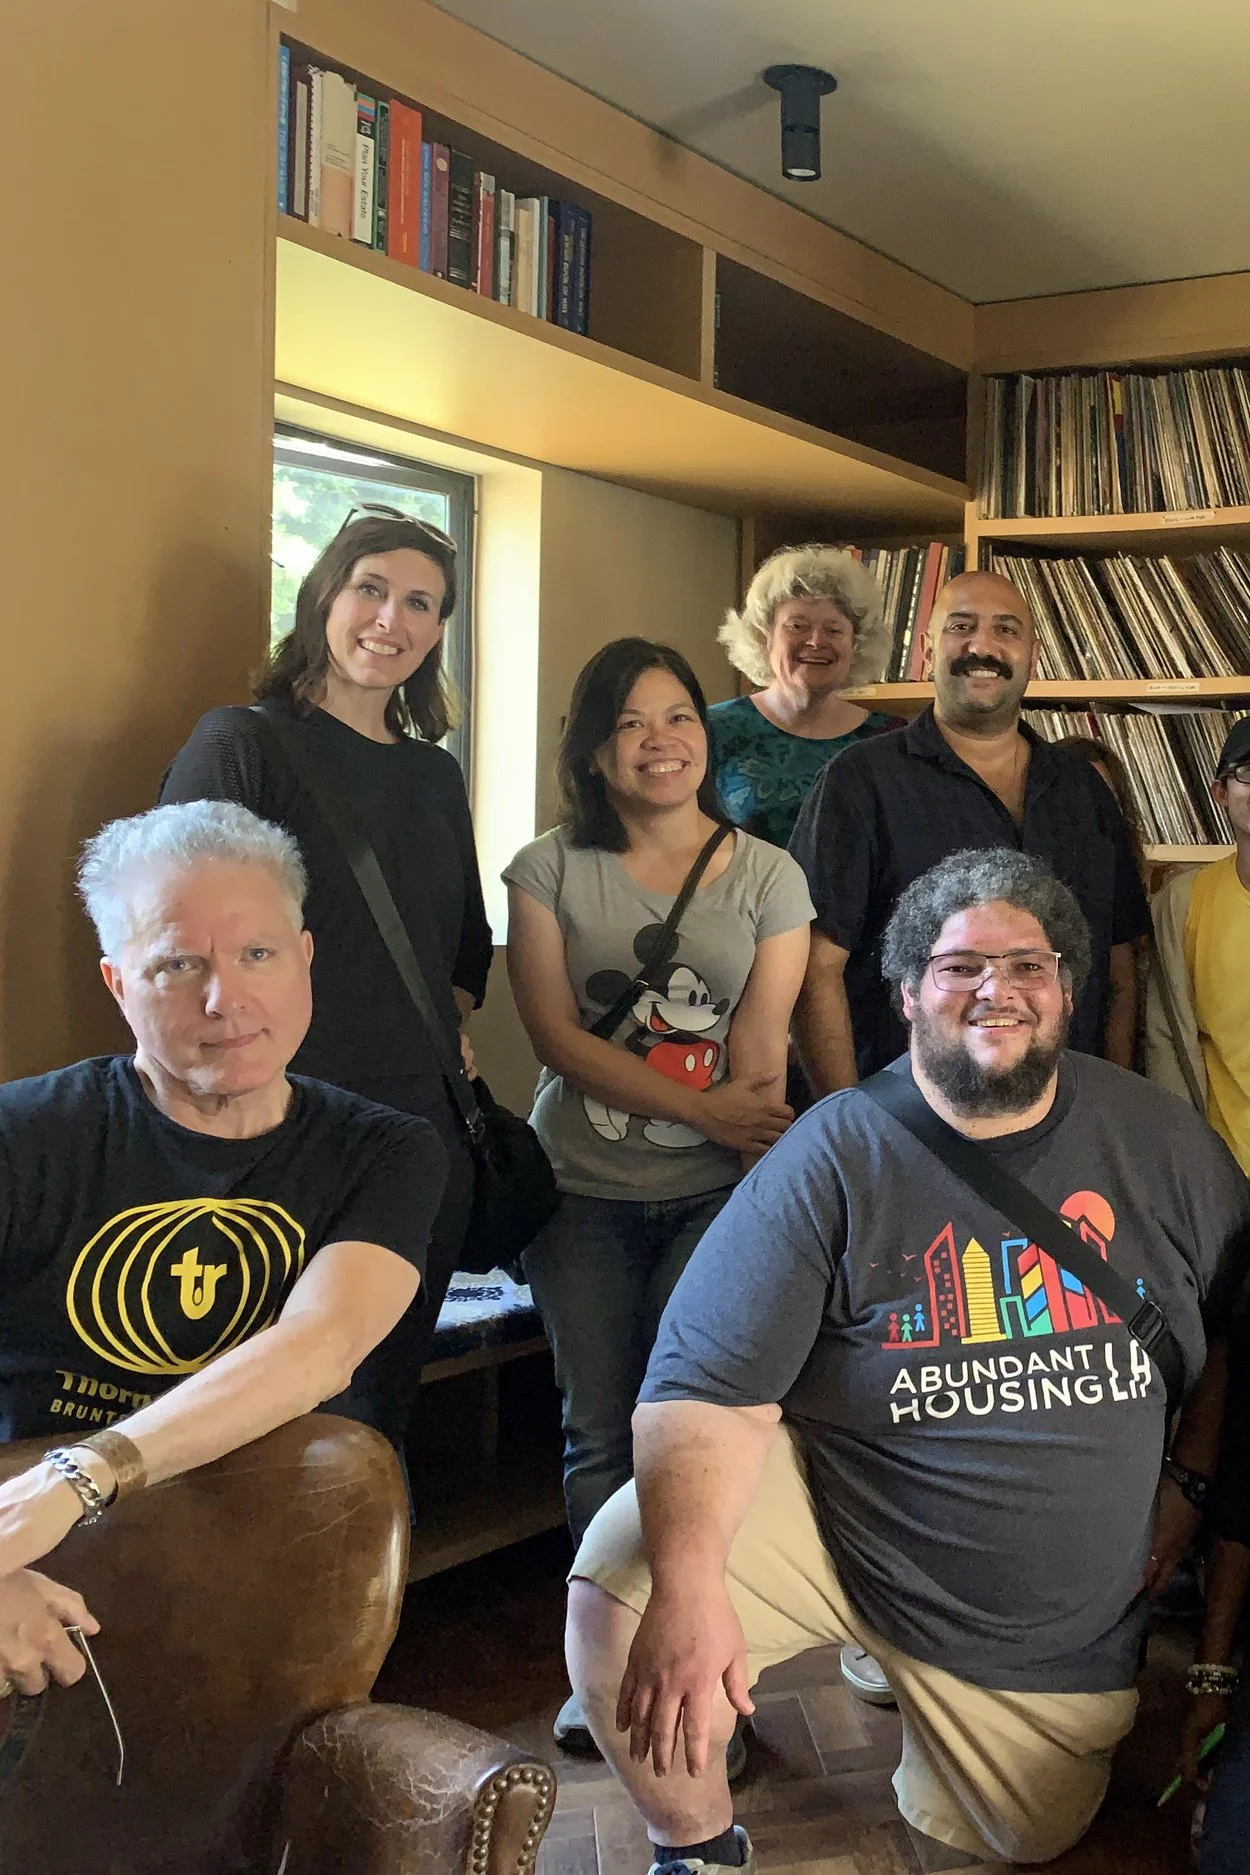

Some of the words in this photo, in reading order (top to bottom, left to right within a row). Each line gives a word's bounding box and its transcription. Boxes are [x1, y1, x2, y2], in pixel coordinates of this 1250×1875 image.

[360, 165, 369, 188] Your
[361, 143, 370, 165] Plan
[360, 189, 369, 219] Estate
[171, 1246, 227, 1319] tr
[889, 1344, 1093, 1395] ABUNDANT
[1104, 1339, 1152, 1402] LA
[889, 1375, 1104, 1424] HOUSING
